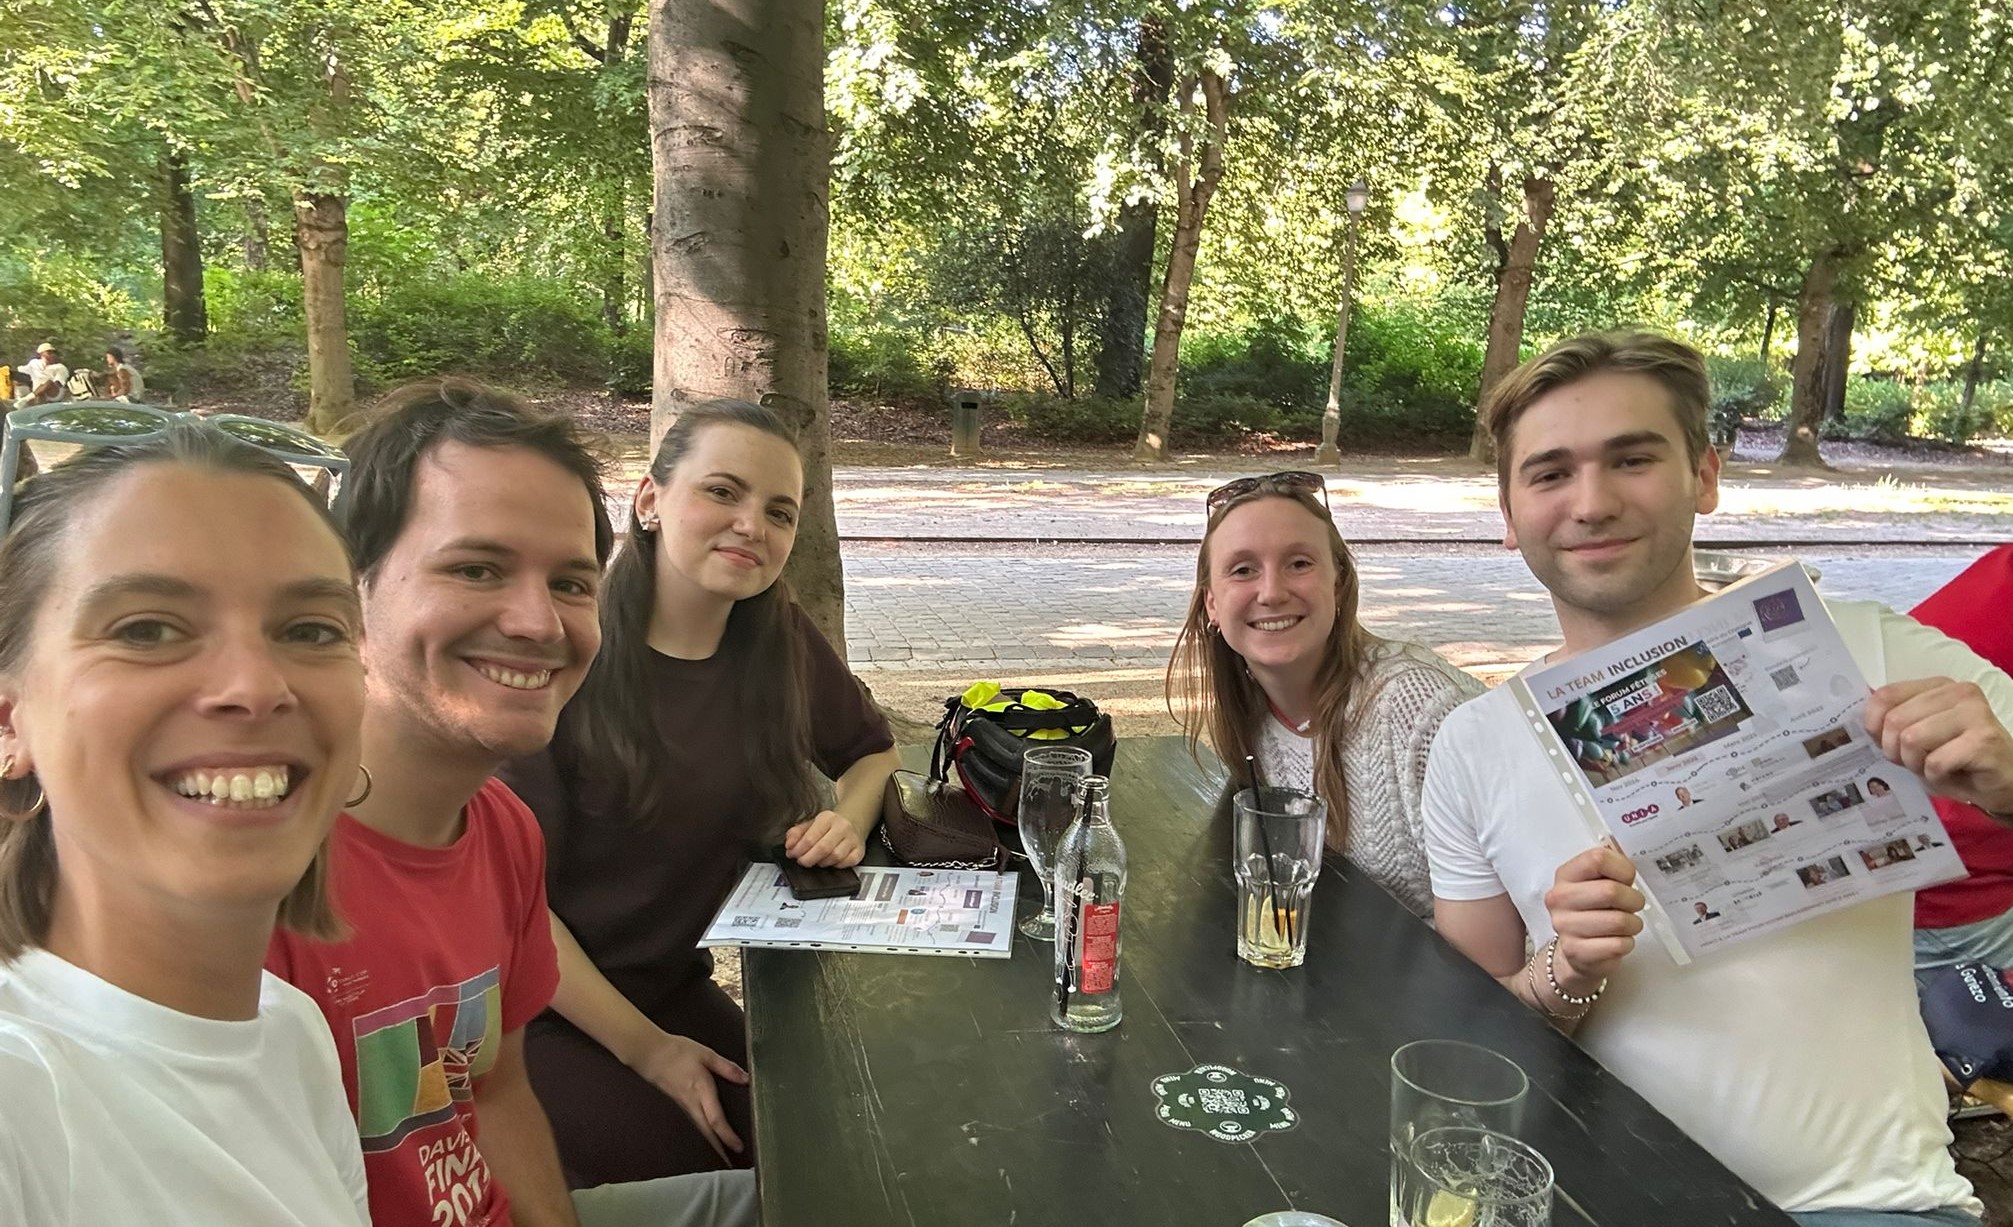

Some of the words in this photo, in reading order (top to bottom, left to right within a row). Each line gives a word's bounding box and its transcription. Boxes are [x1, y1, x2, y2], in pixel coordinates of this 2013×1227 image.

[1547, 687, 1566, 700] LA
[1567, 670, 1606, 692] TEAM
[1607, 635, 1689, 677] INCLUSION
[1600, 686, 1631, 705] FORUM
[1610, 703, 1621, 716] 5
[1623, 688, 1653, 710] ANS
